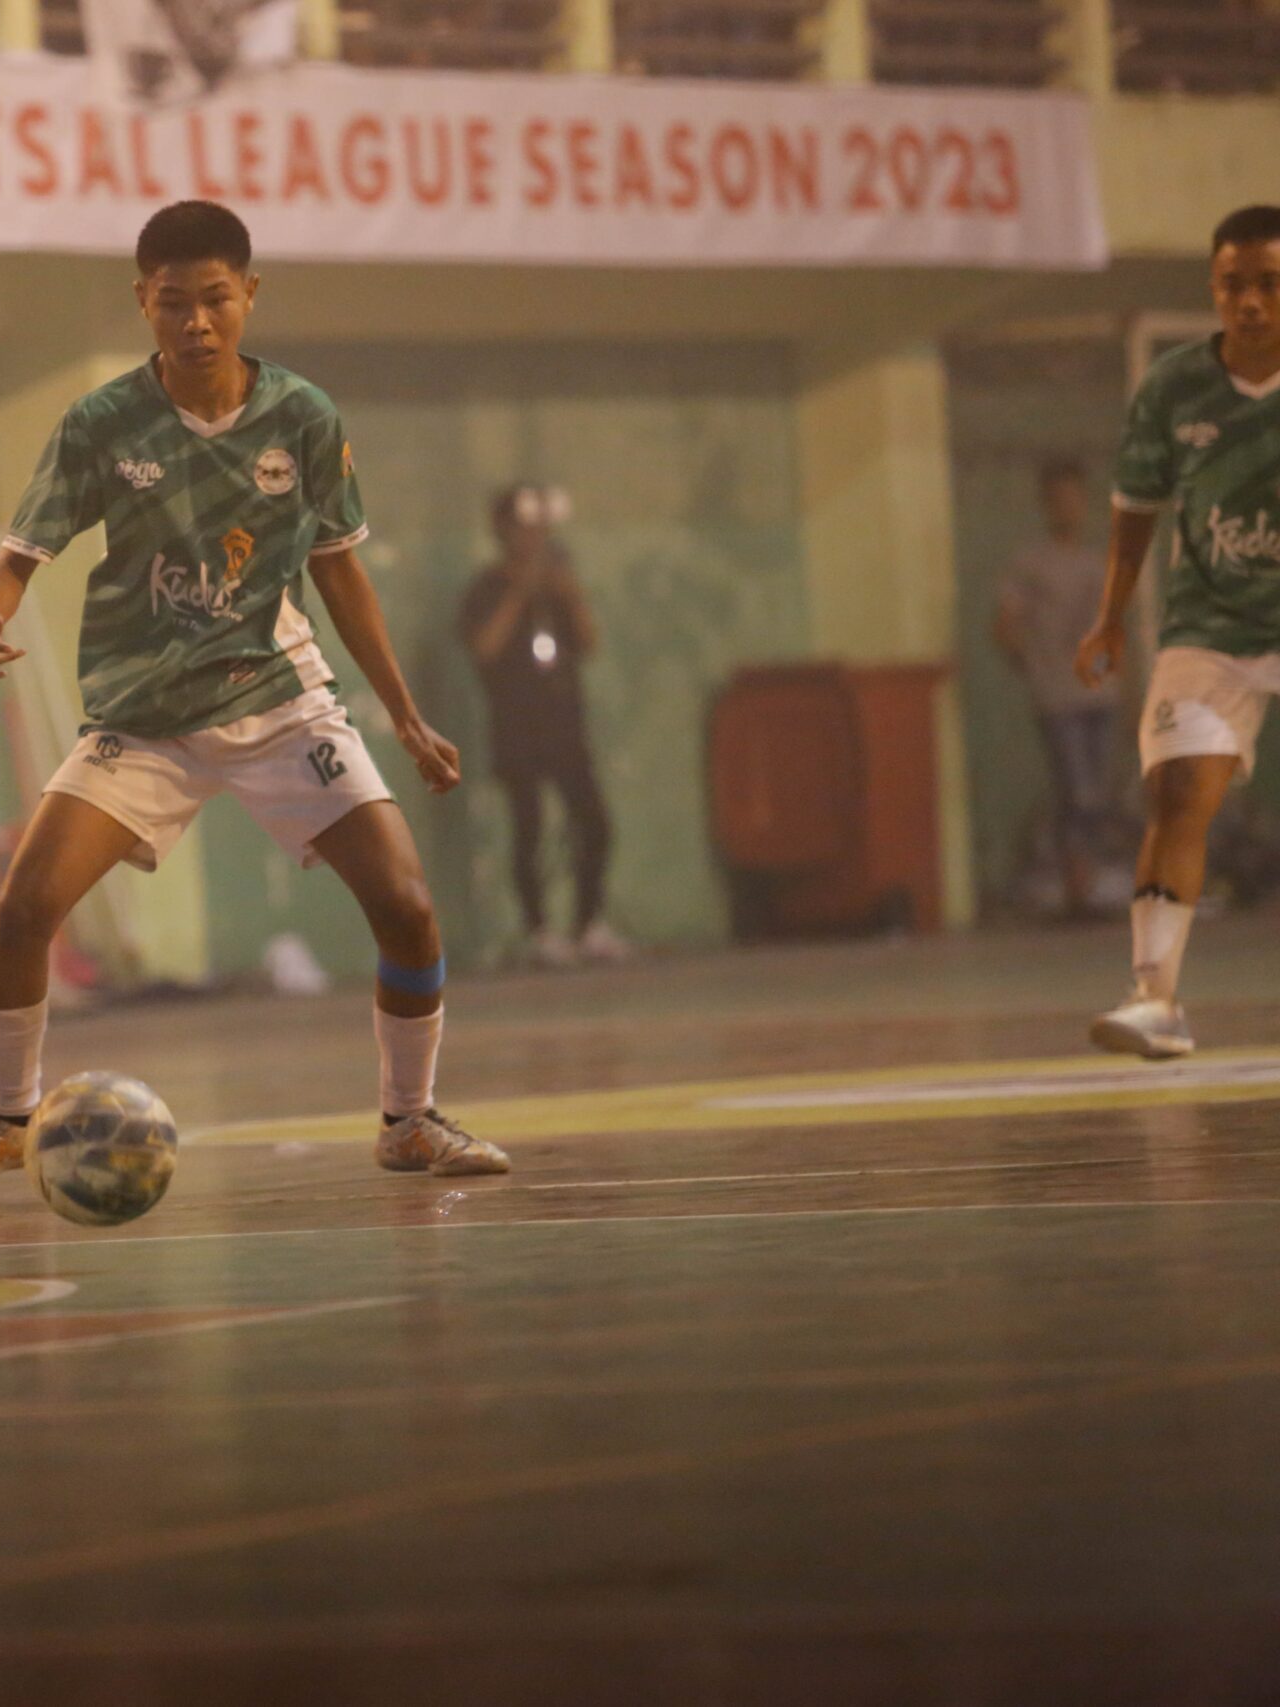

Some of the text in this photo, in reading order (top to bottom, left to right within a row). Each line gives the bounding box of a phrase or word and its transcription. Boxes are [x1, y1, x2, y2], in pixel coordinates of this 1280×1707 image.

[186, 110, 492, 206] LEAGUE
[522, 118, 821, 210] SEASON
[842, 125, 1019, 214] 2023
[307, 742, 348, 787] 12
